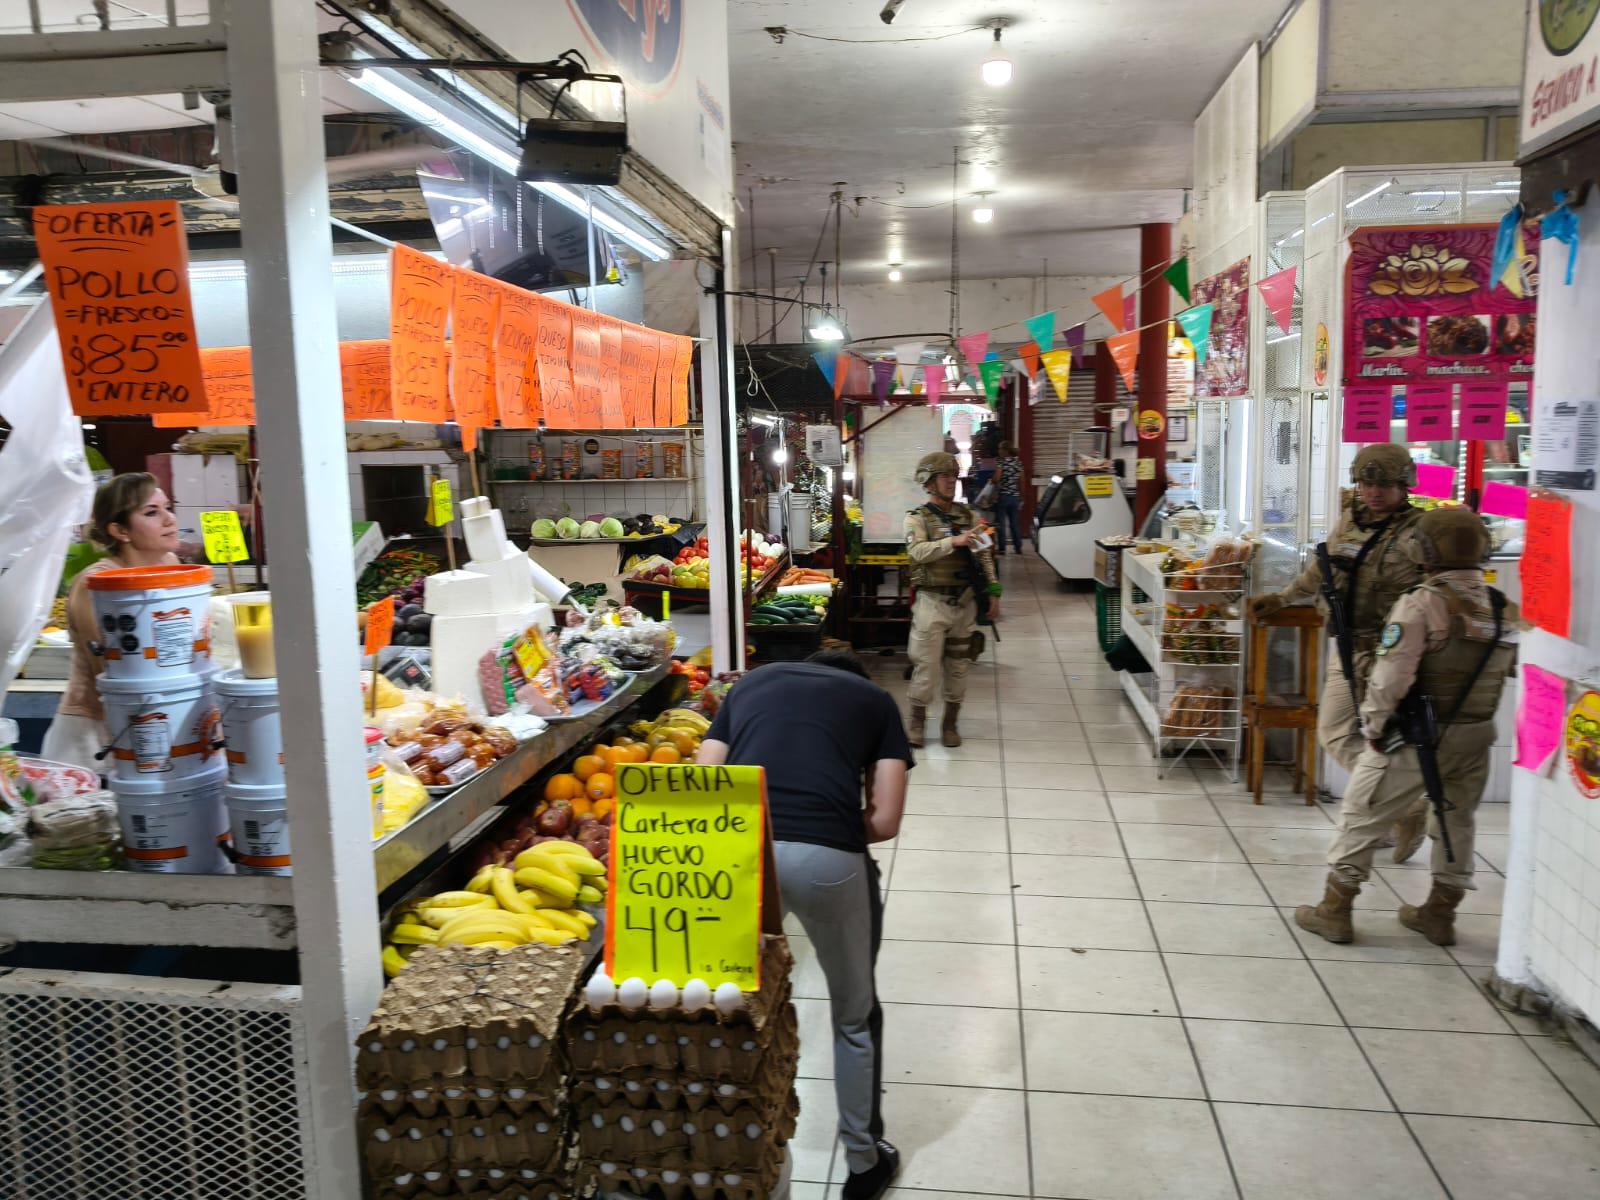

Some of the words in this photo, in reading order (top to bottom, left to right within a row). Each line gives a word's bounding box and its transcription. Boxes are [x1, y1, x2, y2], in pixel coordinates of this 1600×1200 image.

[55, 265, 180, 300] POLLO
[87, 380, 190, 403] ENTERO
[619, 765, 735, 796] OFERTA
[619, 801, 708, 835] Cartera
[714, 803, 749, 833] de
